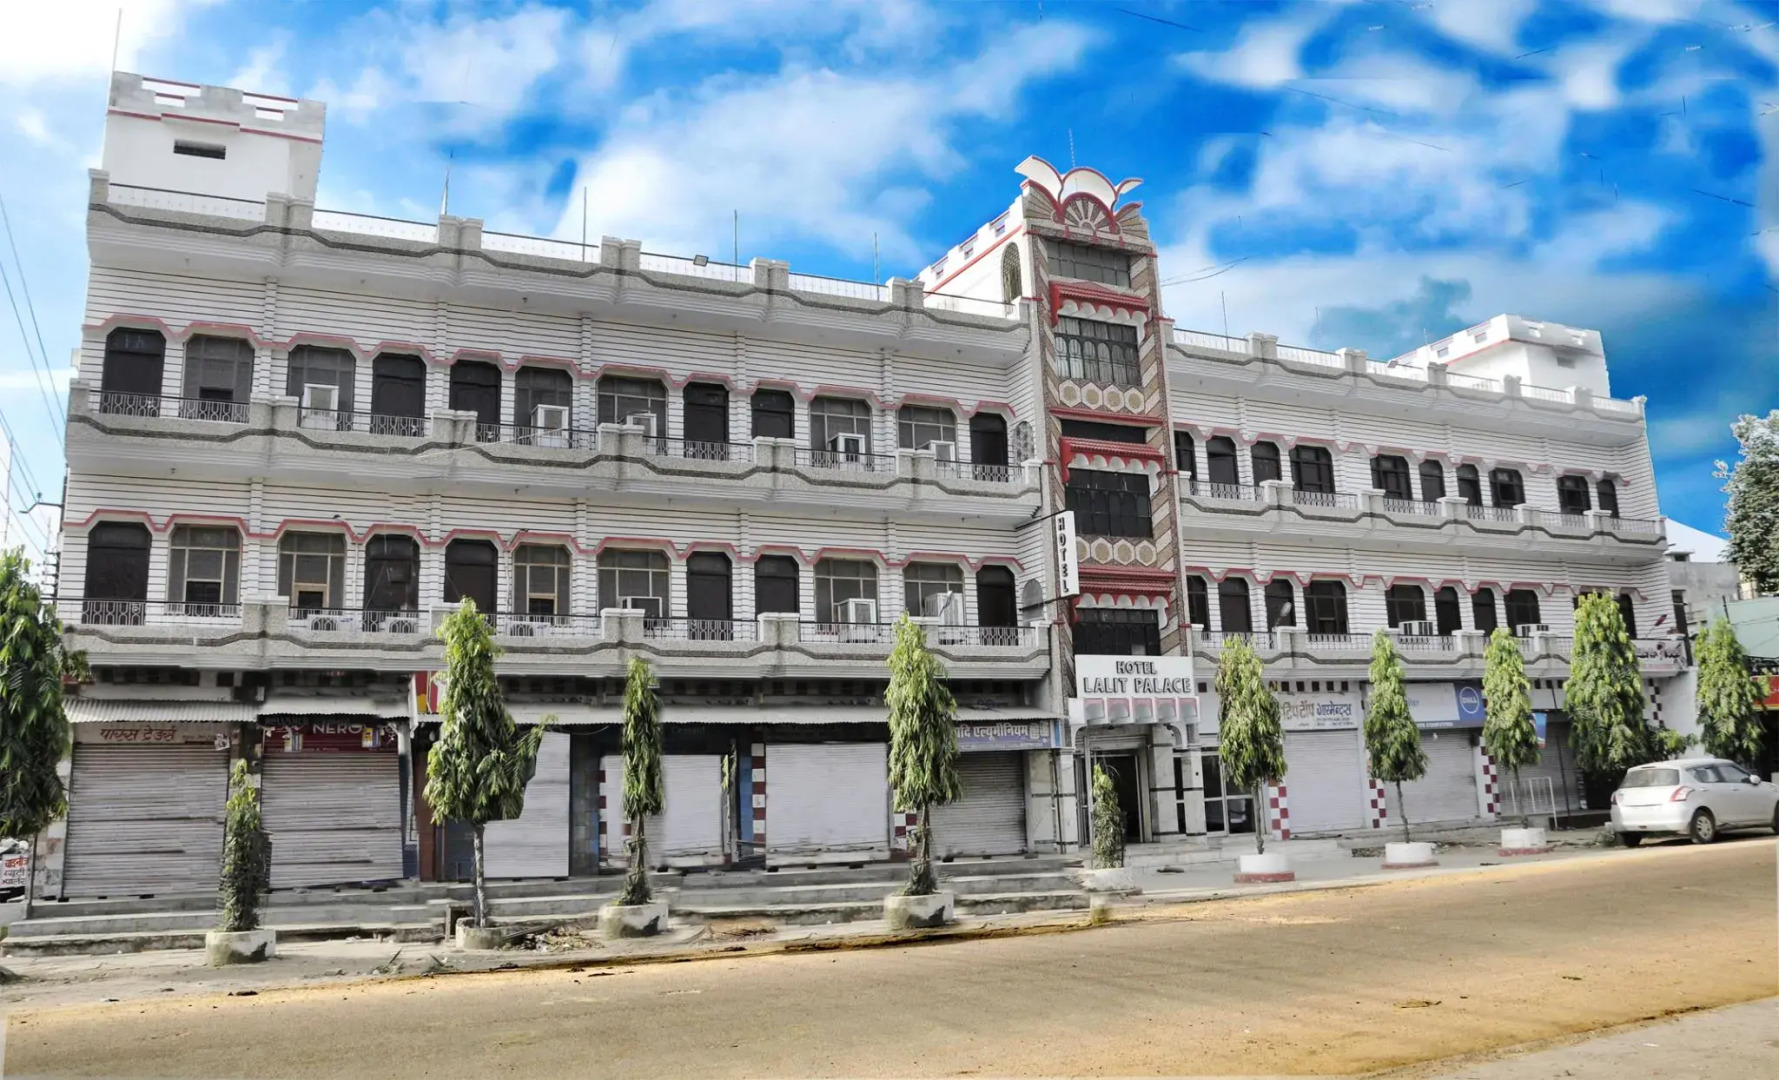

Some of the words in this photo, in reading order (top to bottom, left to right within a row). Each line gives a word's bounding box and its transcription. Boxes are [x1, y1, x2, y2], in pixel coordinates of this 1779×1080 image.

[1058, 517, 1069, 593] HOTEL
[1116, 660, 1157, 675] HOTEL
[1083, 677, 1128, 693] LALIT
[1134, 677, 1191, 693] PALACE
